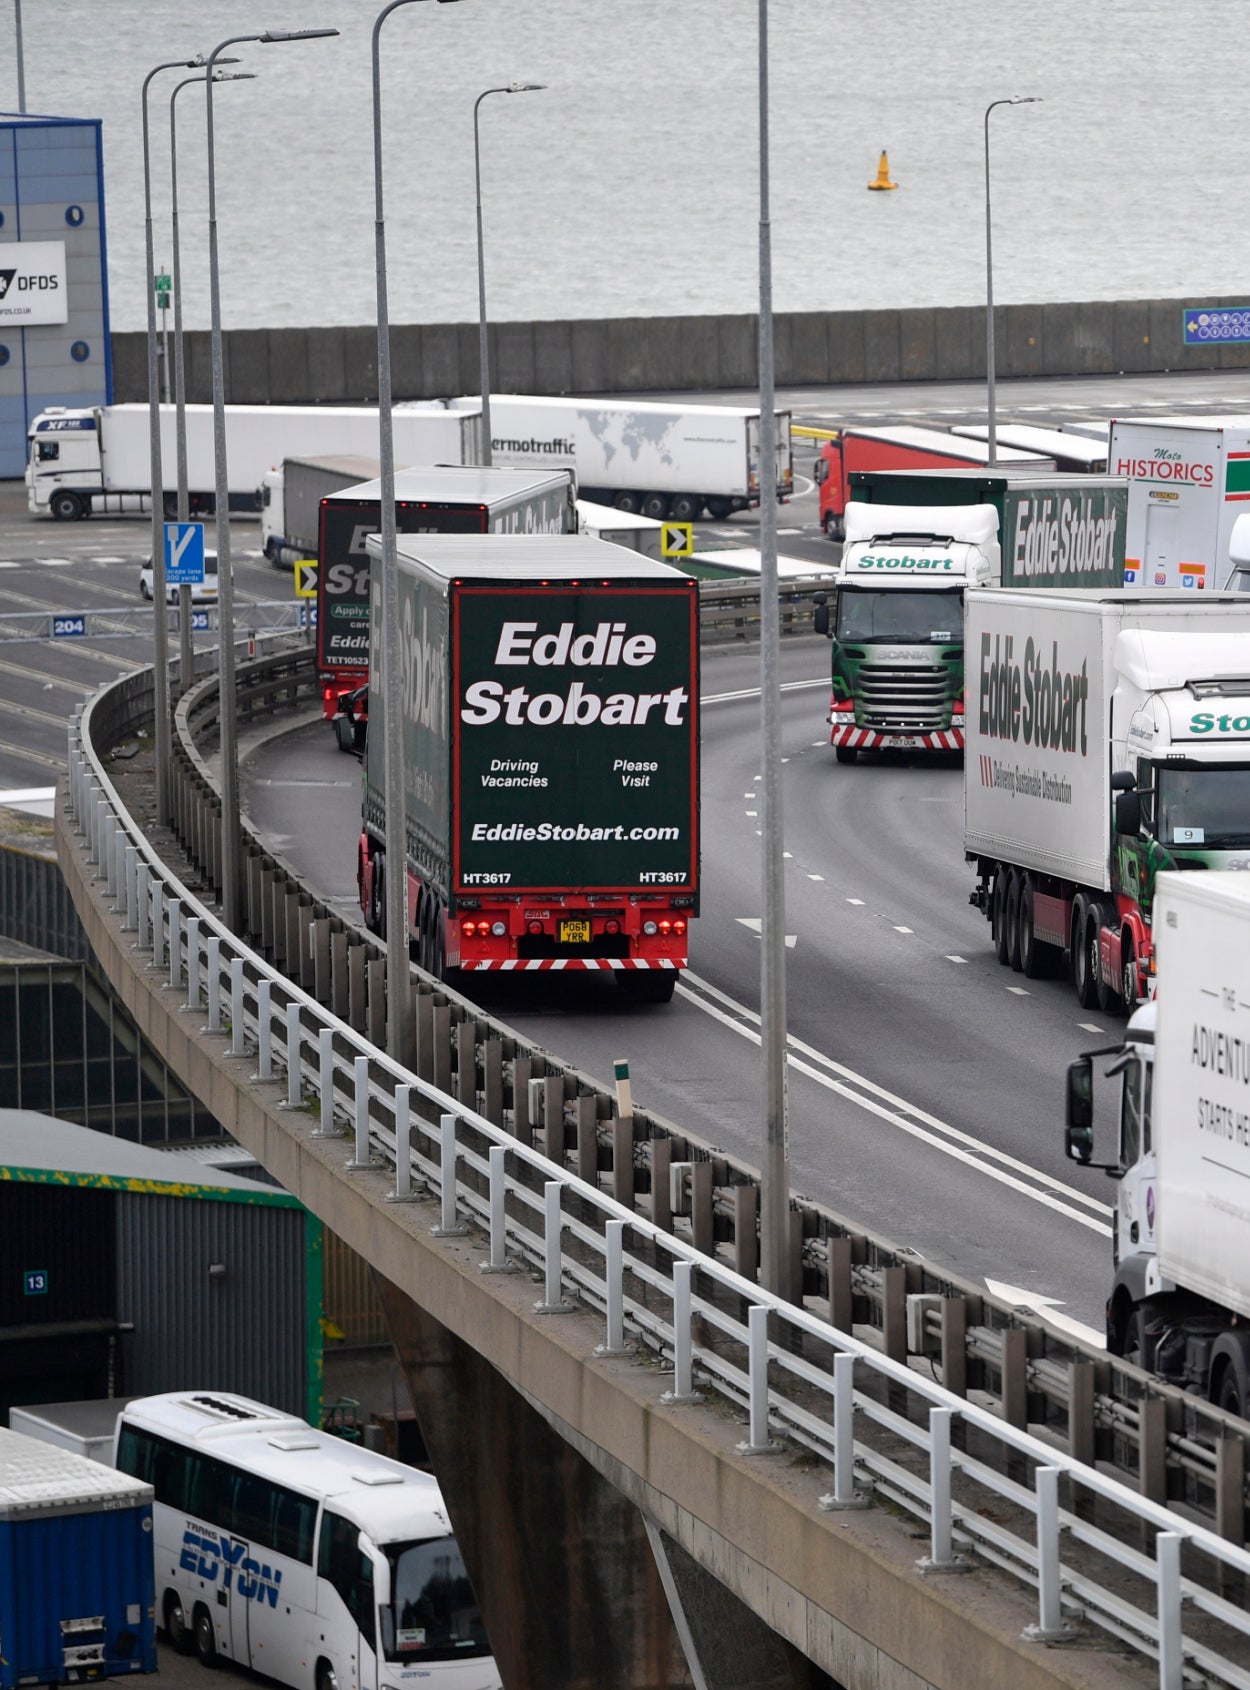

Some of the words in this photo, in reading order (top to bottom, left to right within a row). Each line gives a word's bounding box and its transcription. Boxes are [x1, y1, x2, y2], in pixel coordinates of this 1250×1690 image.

[18, 274, 58, 291] DFDS
[491, 437, 576, 455] ermotraffic
[1153, 448, 1182, 461] Moto
[1117, 458, 1214, 483] HISTORICS
[858, 555, 954, 571] Stobart
[166, 568, 187, 576] scape
[335, 605, 362, 616] Apply
[54, 619, 84, 634] 204
[192, 615, 208, 630] 05
[494, 621, 657, 667] Eddie
[878, 650, 930, 660] SCANIA
[460, 680, 689, 726] Stobart
[490, 759, 539, 774] Driving
[613, 759, 658, 772] Please
[481, 775, 548, 788] Vacancies
[621, 775, 650, 787] Visit
[471, 823, 680, 842] EddieStobart.com
[1184, 829, 1193, 841] 9
[463, 873, 511, 884] HT3617
[639, 872, 687, 883] HT3617
[566, 932, 584, 943] YRR
[1222, 986, 1236, 1012] THE
[1198, 1097, 1234, 1141] STARTS
[28, 1275, 45, 1289] 13
[186, 1520, 218, 1541] TRANS
[180, 1530, 283, 1609] EDYON
